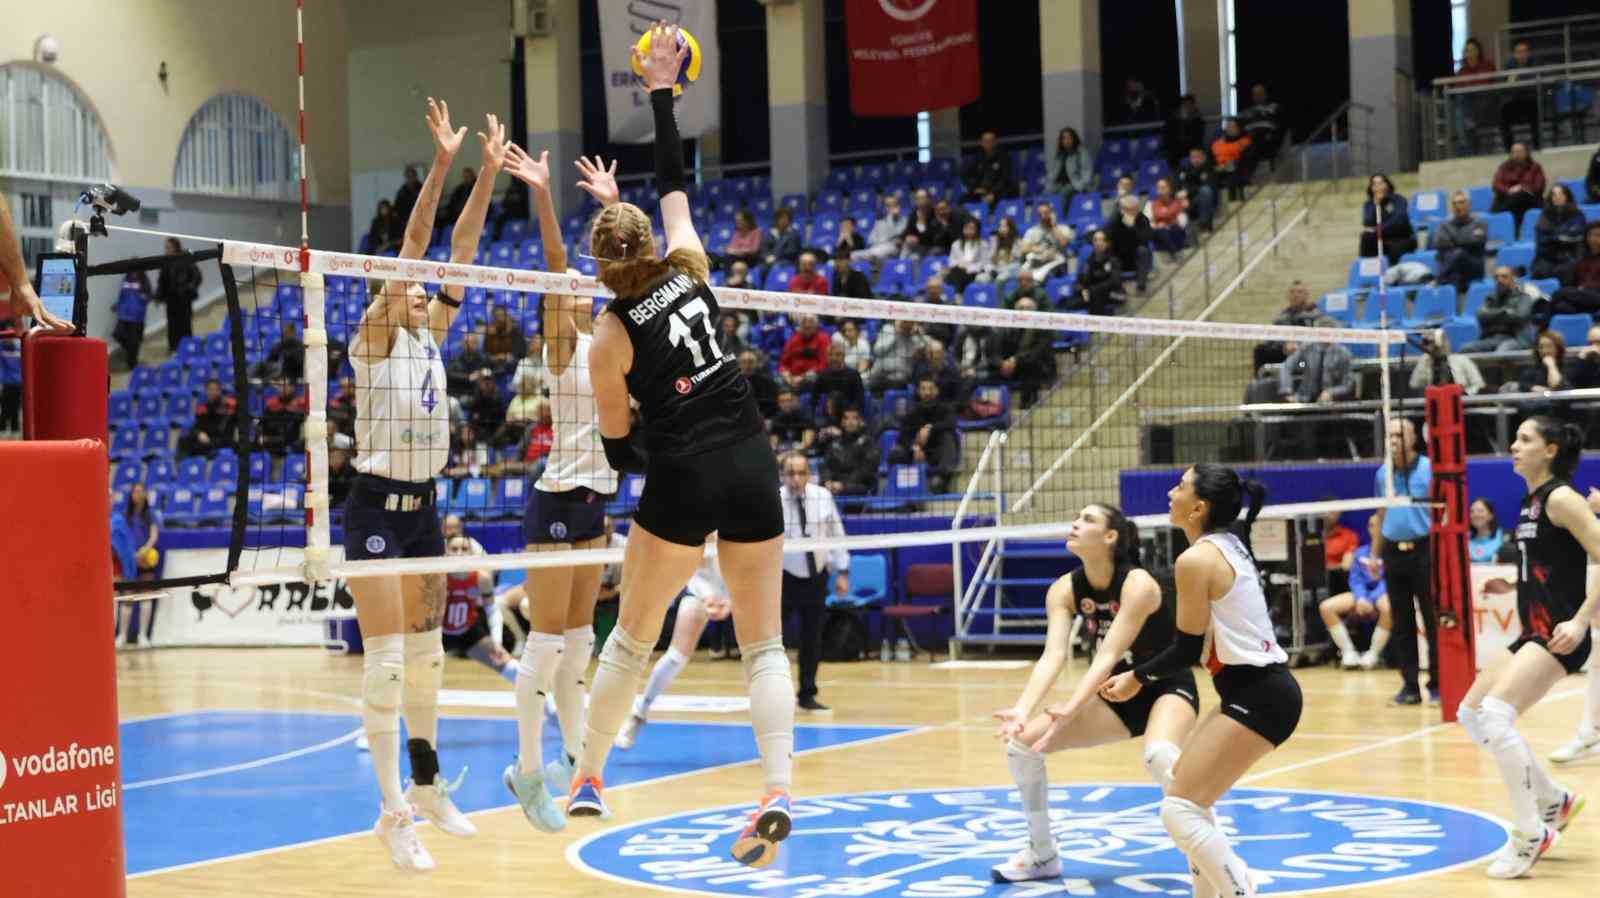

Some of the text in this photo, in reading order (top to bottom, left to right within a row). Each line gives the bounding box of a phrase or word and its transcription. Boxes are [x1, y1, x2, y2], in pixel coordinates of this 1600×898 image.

[668, 296, 723, 368] 17
[420, 368, 439, 414] 4
[447, 602, 468, 627] 10
[12, 742, 114, 777] vodafone
